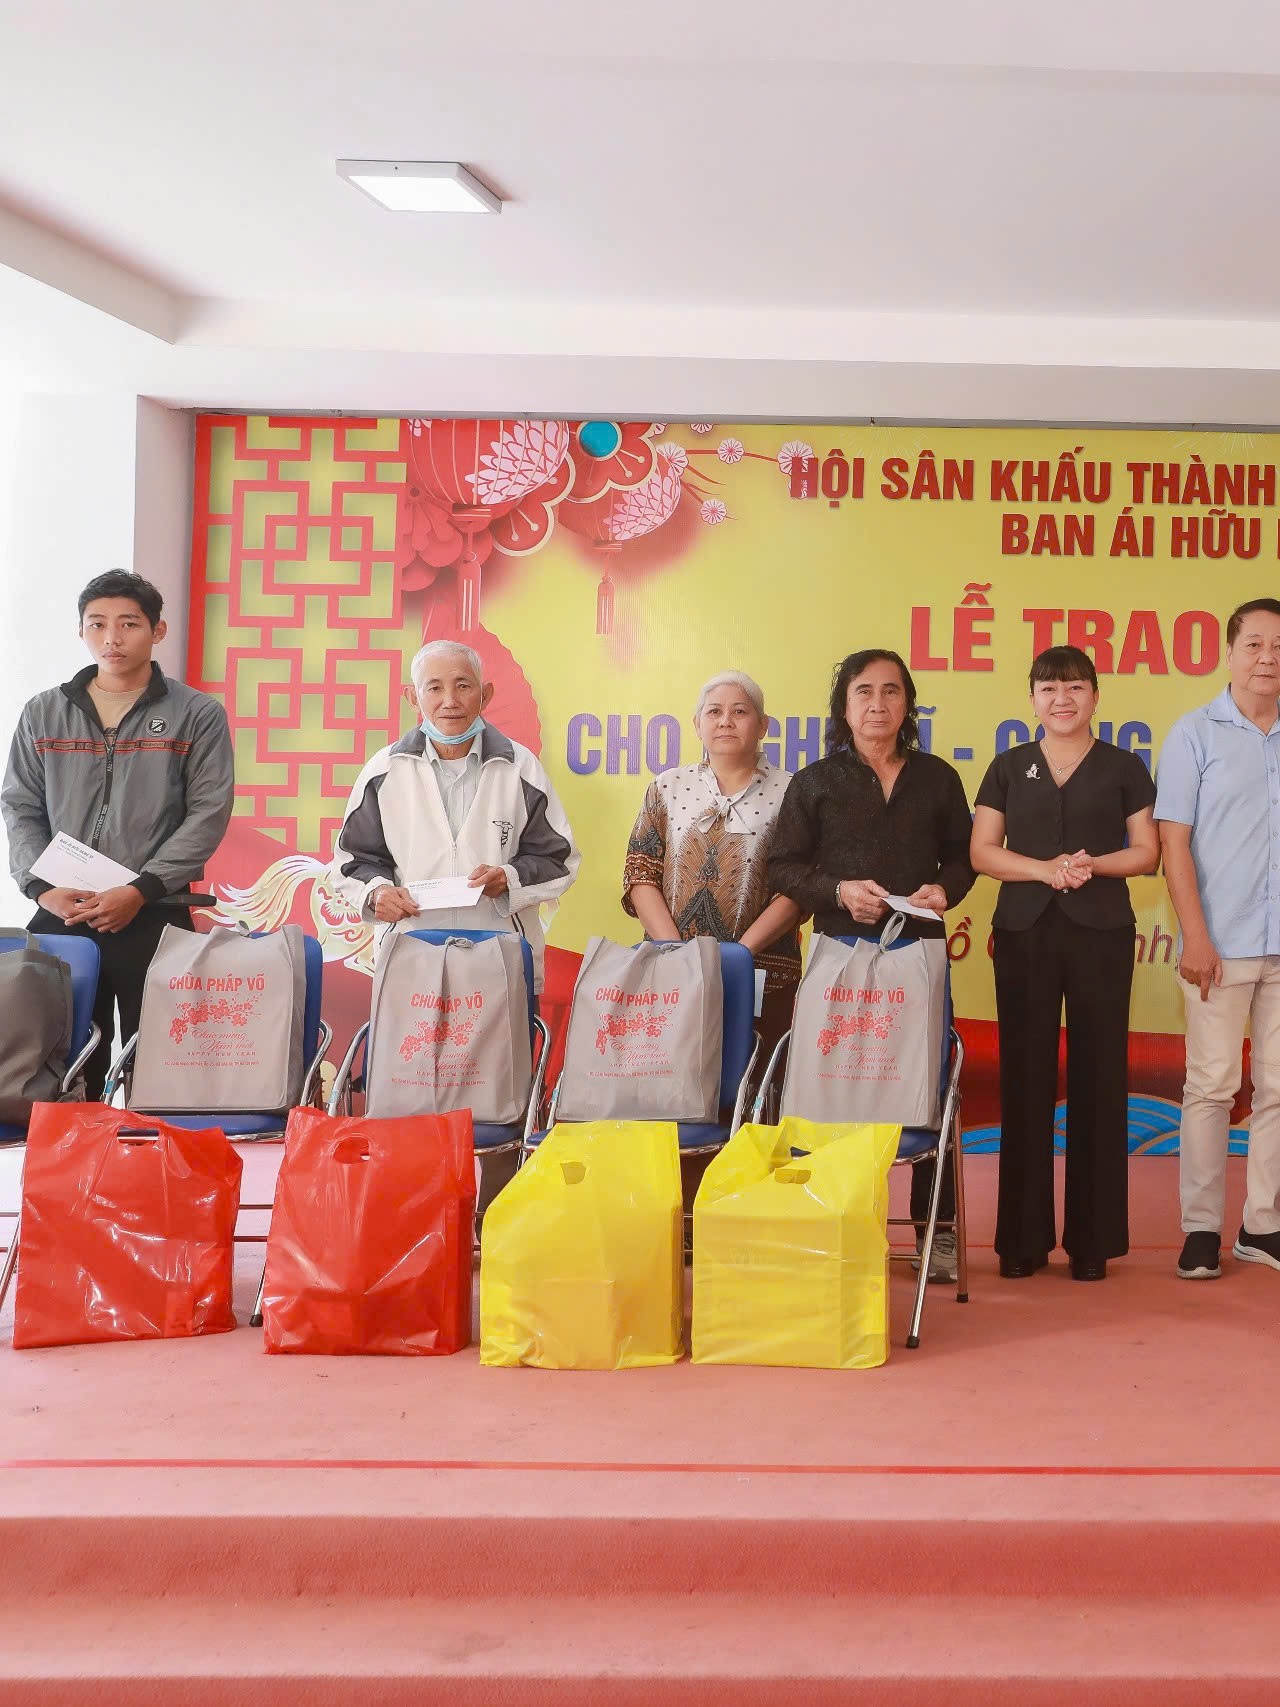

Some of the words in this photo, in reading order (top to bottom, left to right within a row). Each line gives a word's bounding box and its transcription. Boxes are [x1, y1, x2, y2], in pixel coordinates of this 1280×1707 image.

[789, 448, 864, 508] HỘI
[881, 450, 974, 501] SÂN
[991, 446, 1111, 503] KHẤU
[1127, 454, 1276, 506] THÀNH
[1001, 513, 1095, 556] BAN
[1109, 506, 1154, 557] ÁI
[1171, 508, 1261, 560] HỮU
[910, 582, 994, 672] LỄ
[1022, 608, 1220, 676] TRAO
[566, 712, 681, 775] CHO
[169, 971, 202, 991] CHÙA
[206, 973, 243, 992] PHÁP
[247, 973, 265, 991] VÕ
[410, 990, 442, 1010] CHÙA
[465, 991, 483, 1009] VÕ
[596, 984, 625, 1005] CHÙA
[626, 988, 659, 1007] PHÁP
[662, 988, 680, 1005] VÕ
[823, 984, 854, 1002] CHÙA
[856, 986, 884, 1004] PHÁP
[887, 987, 905, 1004] VÕ
